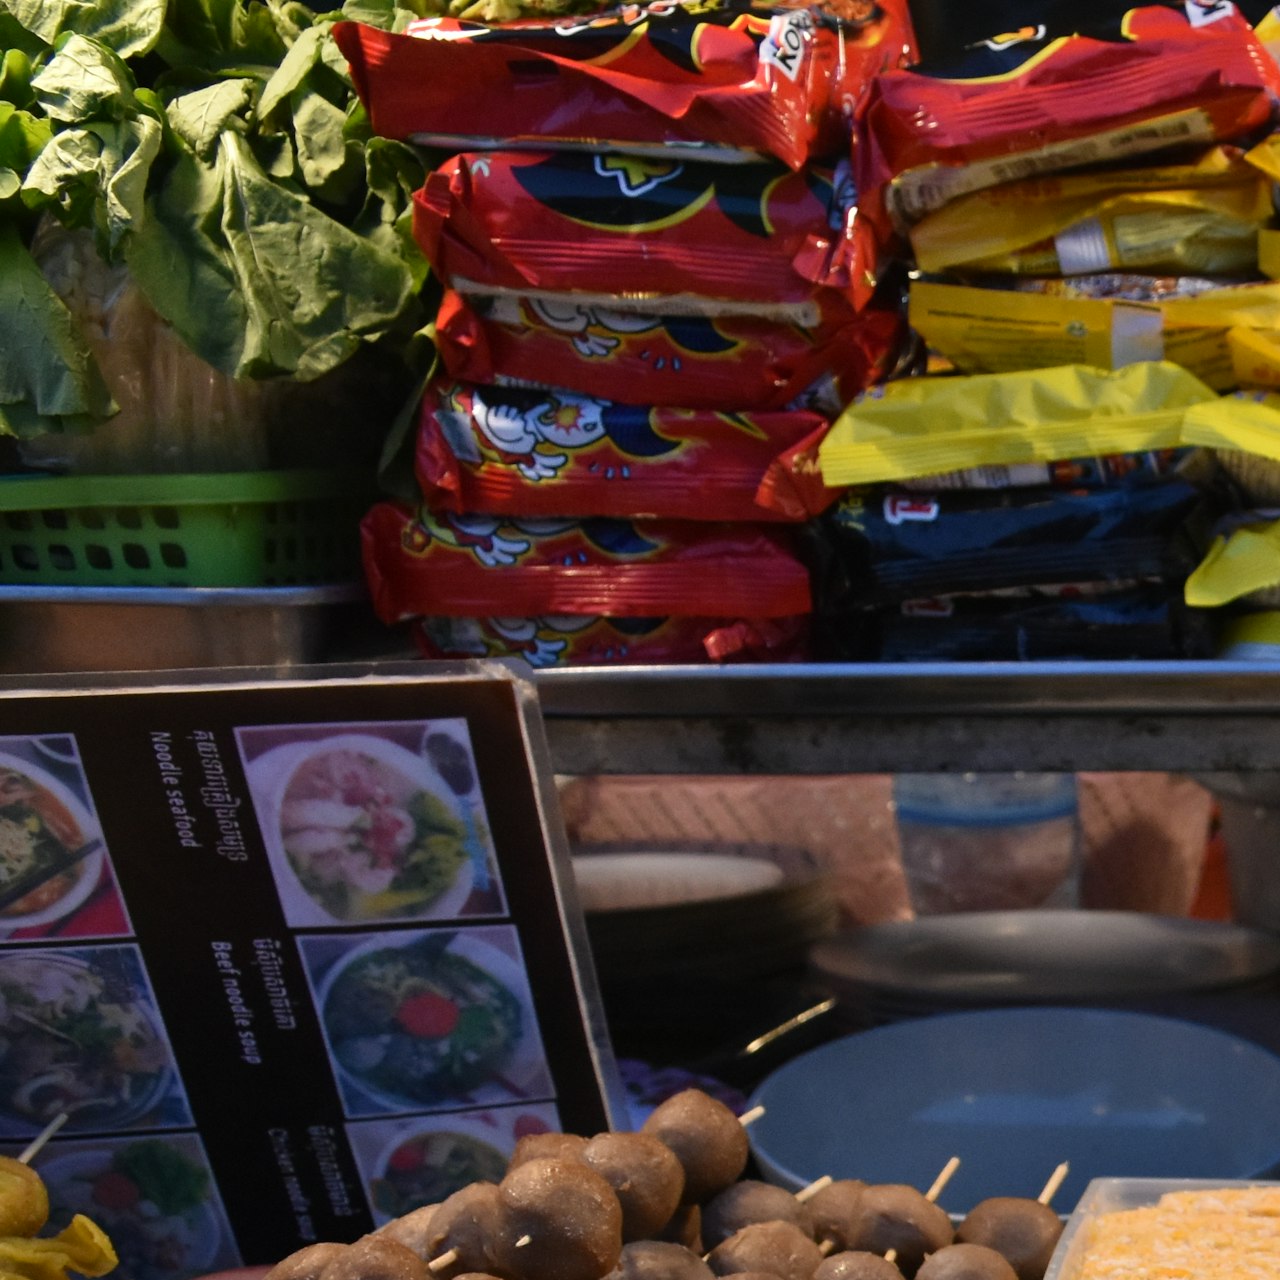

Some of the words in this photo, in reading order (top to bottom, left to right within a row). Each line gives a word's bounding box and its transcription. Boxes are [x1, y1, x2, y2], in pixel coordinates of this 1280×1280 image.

[150, 731, 183, 785] Noodle
[166, 789, 203, 848] seafood
[211, 941, 241, 976] Beef
[223, 978, 253, 1026] noodle
[238, 1029, 262, 1065] soup
